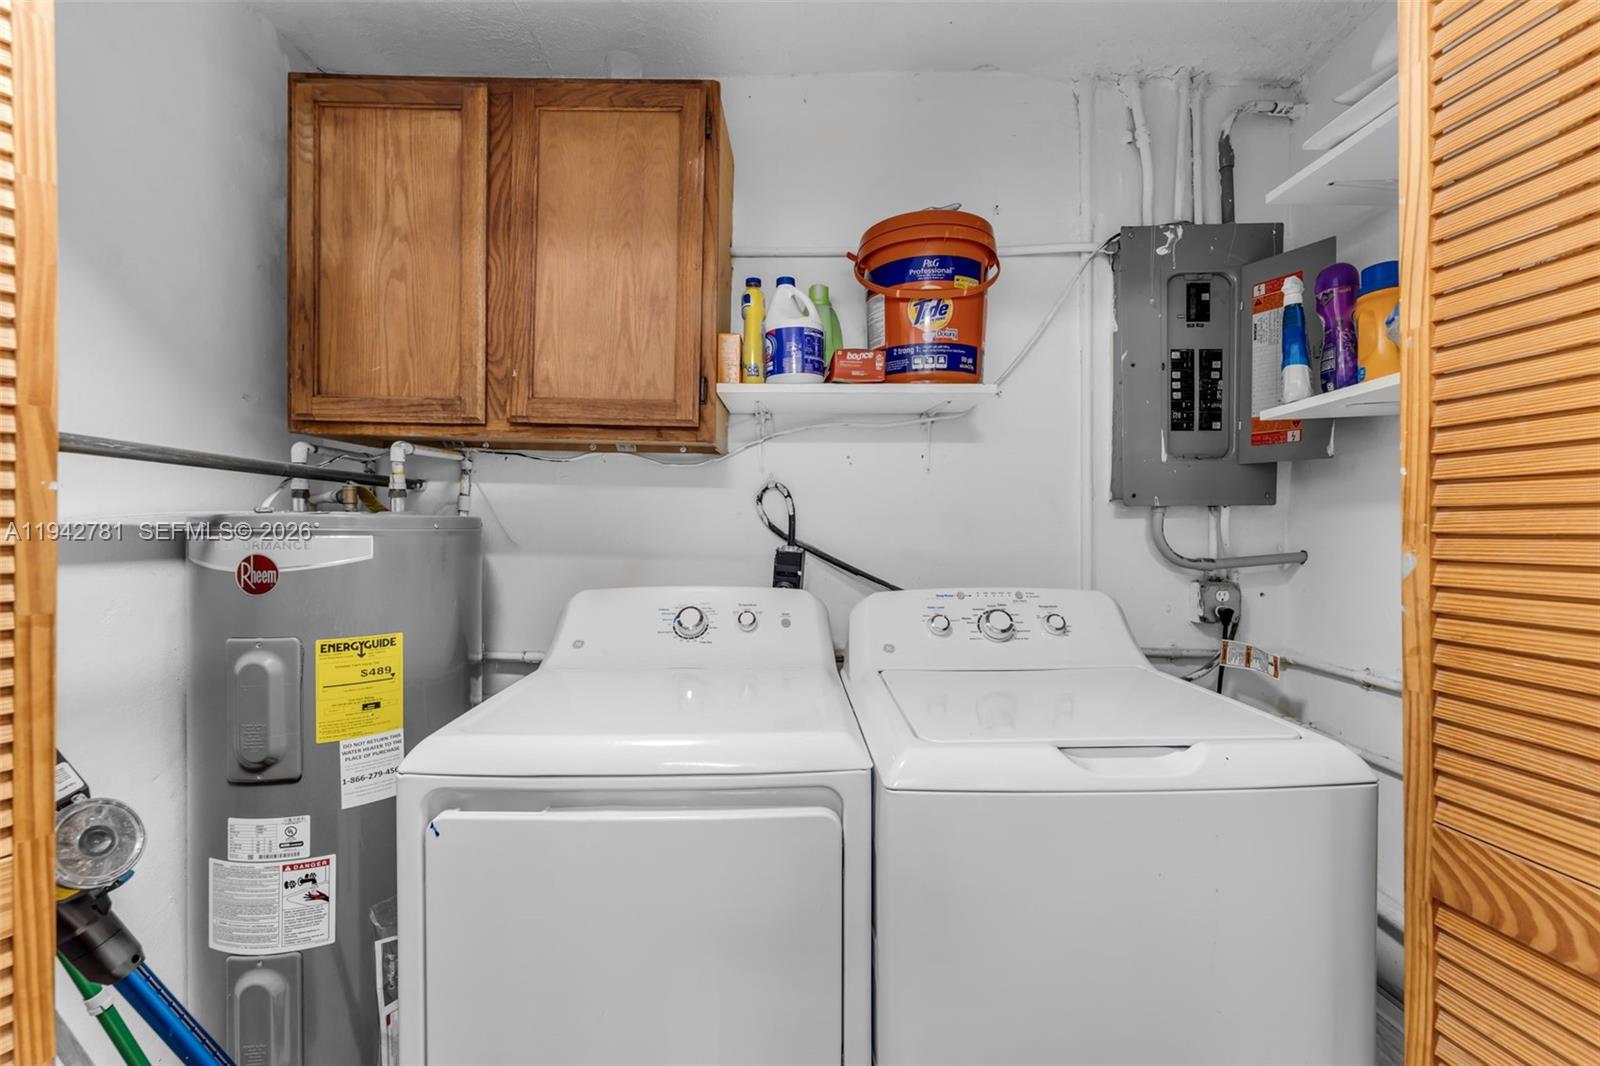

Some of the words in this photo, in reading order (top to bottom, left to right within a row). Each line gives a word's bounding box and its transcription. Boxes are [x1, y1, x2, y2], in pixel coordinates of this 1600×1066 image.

[922, 258, 940, 268] P&G
[909, 267, 953, 275] Professional
[913, 298, 949, 326] Tide
[846, 351, 874, 360] bounce
[240, 555, 277, 590] Rheem
[366, 736, 389, 744] RETURN
[341, 748, 362, 756] WATER
[362, 744, 383, 752] HEATER
[372, 746, 400, 757] PURCHASE
[293, 861, 328, 870] DANGER
